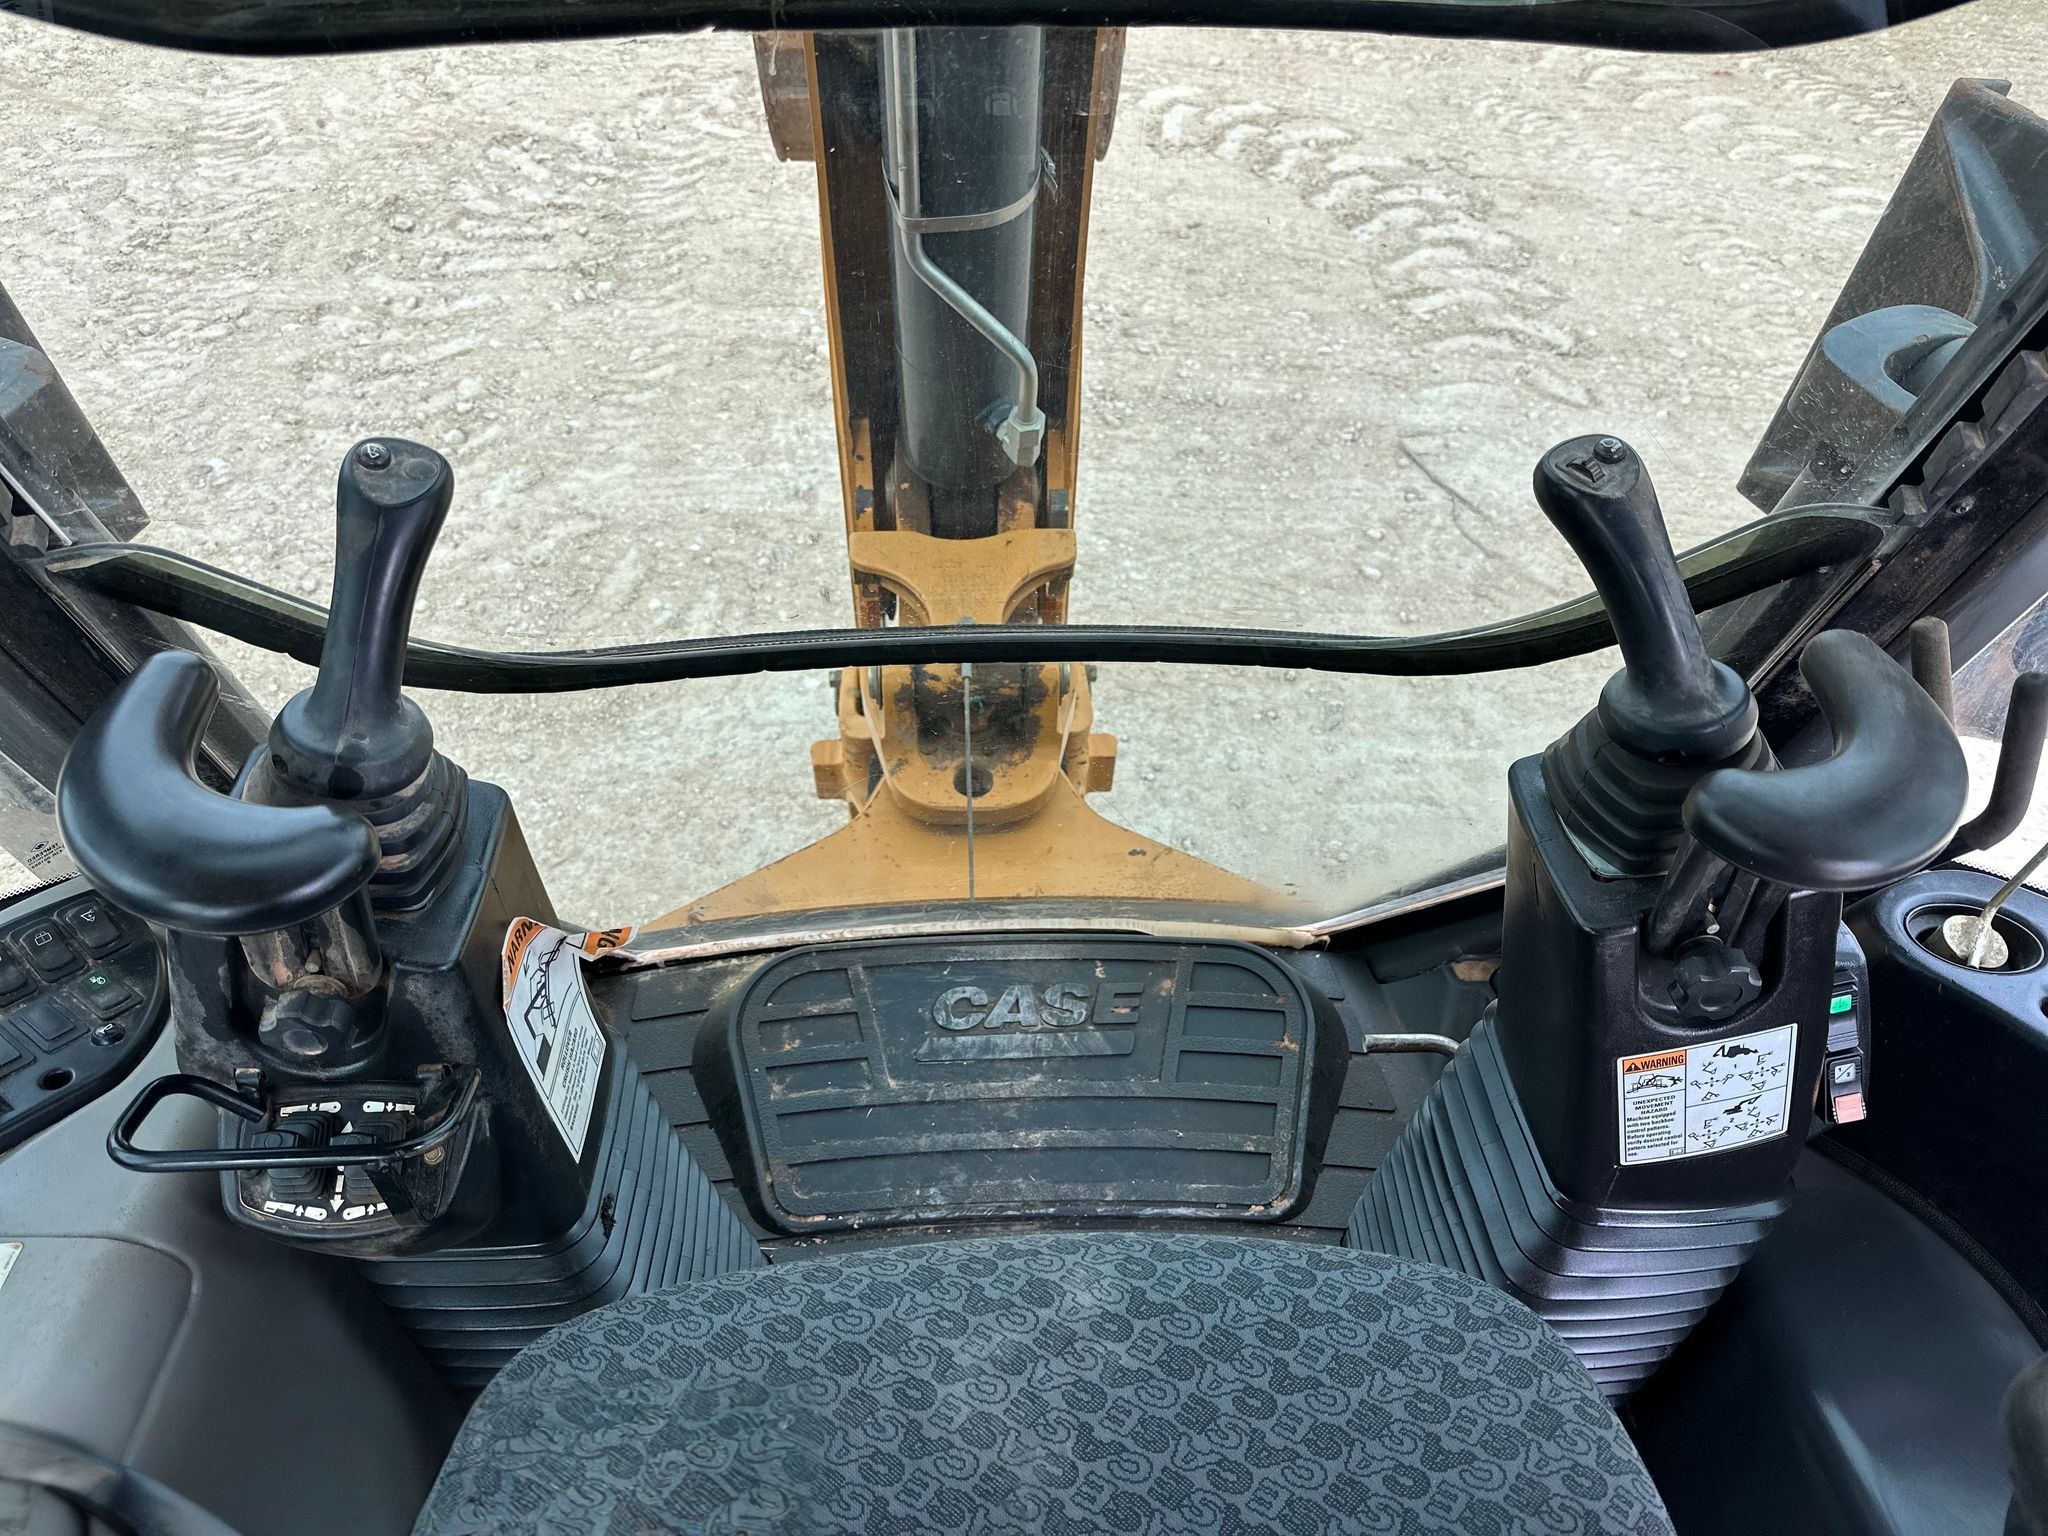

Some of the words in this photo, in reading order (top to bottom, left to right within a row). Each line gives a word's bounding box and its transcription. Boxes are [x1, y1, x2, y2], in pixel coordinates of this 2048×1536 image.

[932, 982, 1145, 1030] CASE
[1640, 1054, 1685, 1070] WARNING
[1633, 1095, 1676, 1105] UNEXPECTED
[1635, 1101, 1673, 1110] MOVEMENT
[1641, 1107, 1668, 1115] HAZARD
